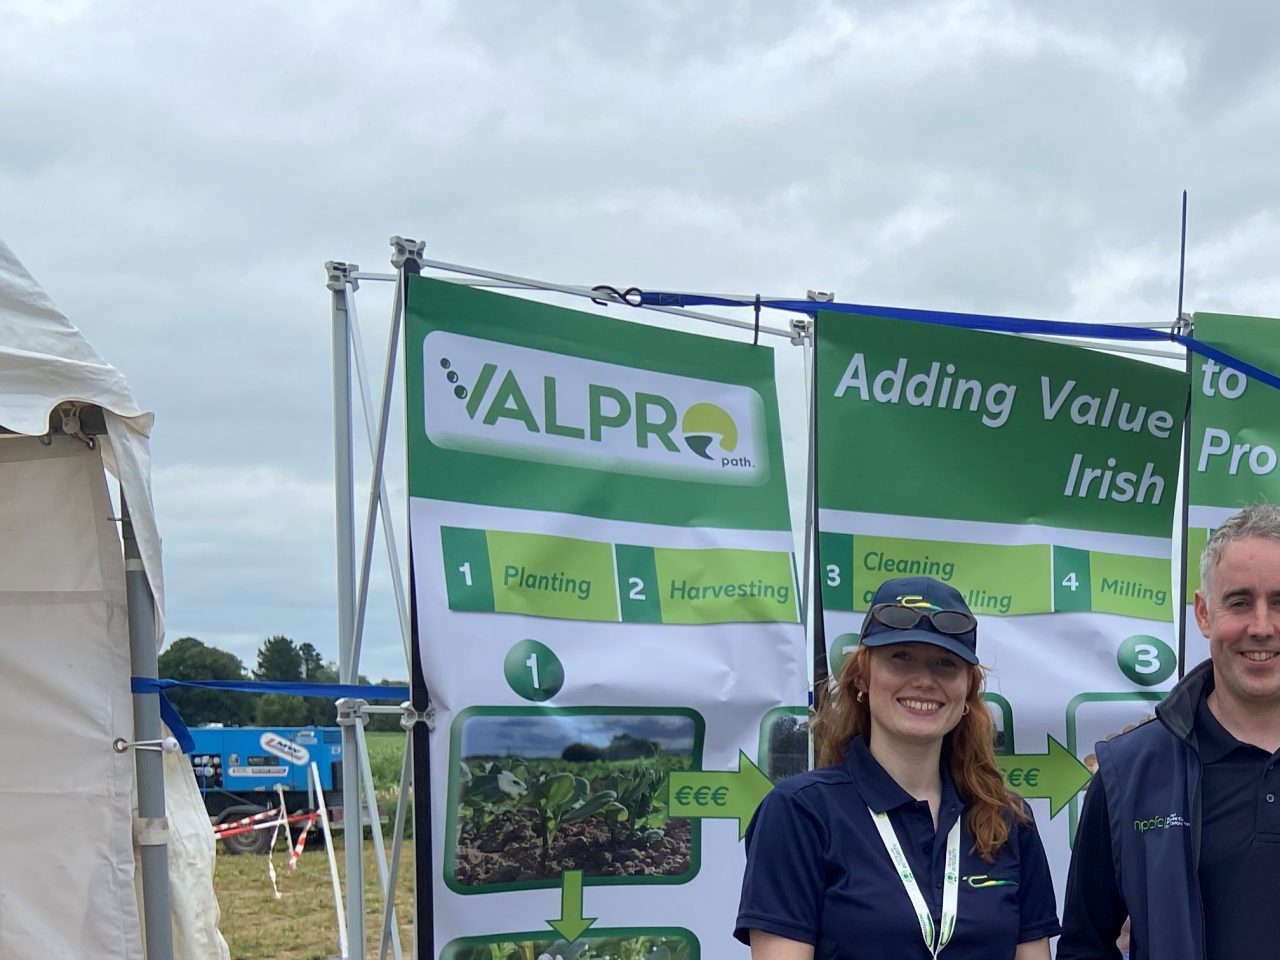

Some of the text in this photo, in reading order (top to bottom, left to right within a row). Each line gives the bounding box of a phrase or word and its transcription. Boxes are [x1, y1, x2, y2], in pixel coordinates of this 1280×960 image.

[834, 352, 1174, 439] Adding Value
[1201, 358, 1248, 399] to
[721, 454, 755, 469] path.
[1063, 453, 1166, 505] Irish
[458, 561, 592, 601] 1 Planting
[826, 551, 955, 587] 3 Cleaning
[628, 576, 790, 604] 2 Harvesting
[964, 590, 1012, 613] lling
[1062, 572, 1167, 606] 4 Milling
[526, 653, 540, 689] 1
[1134, 644, 1161, 674] 3
[674, 785, 730, 807] €€€
